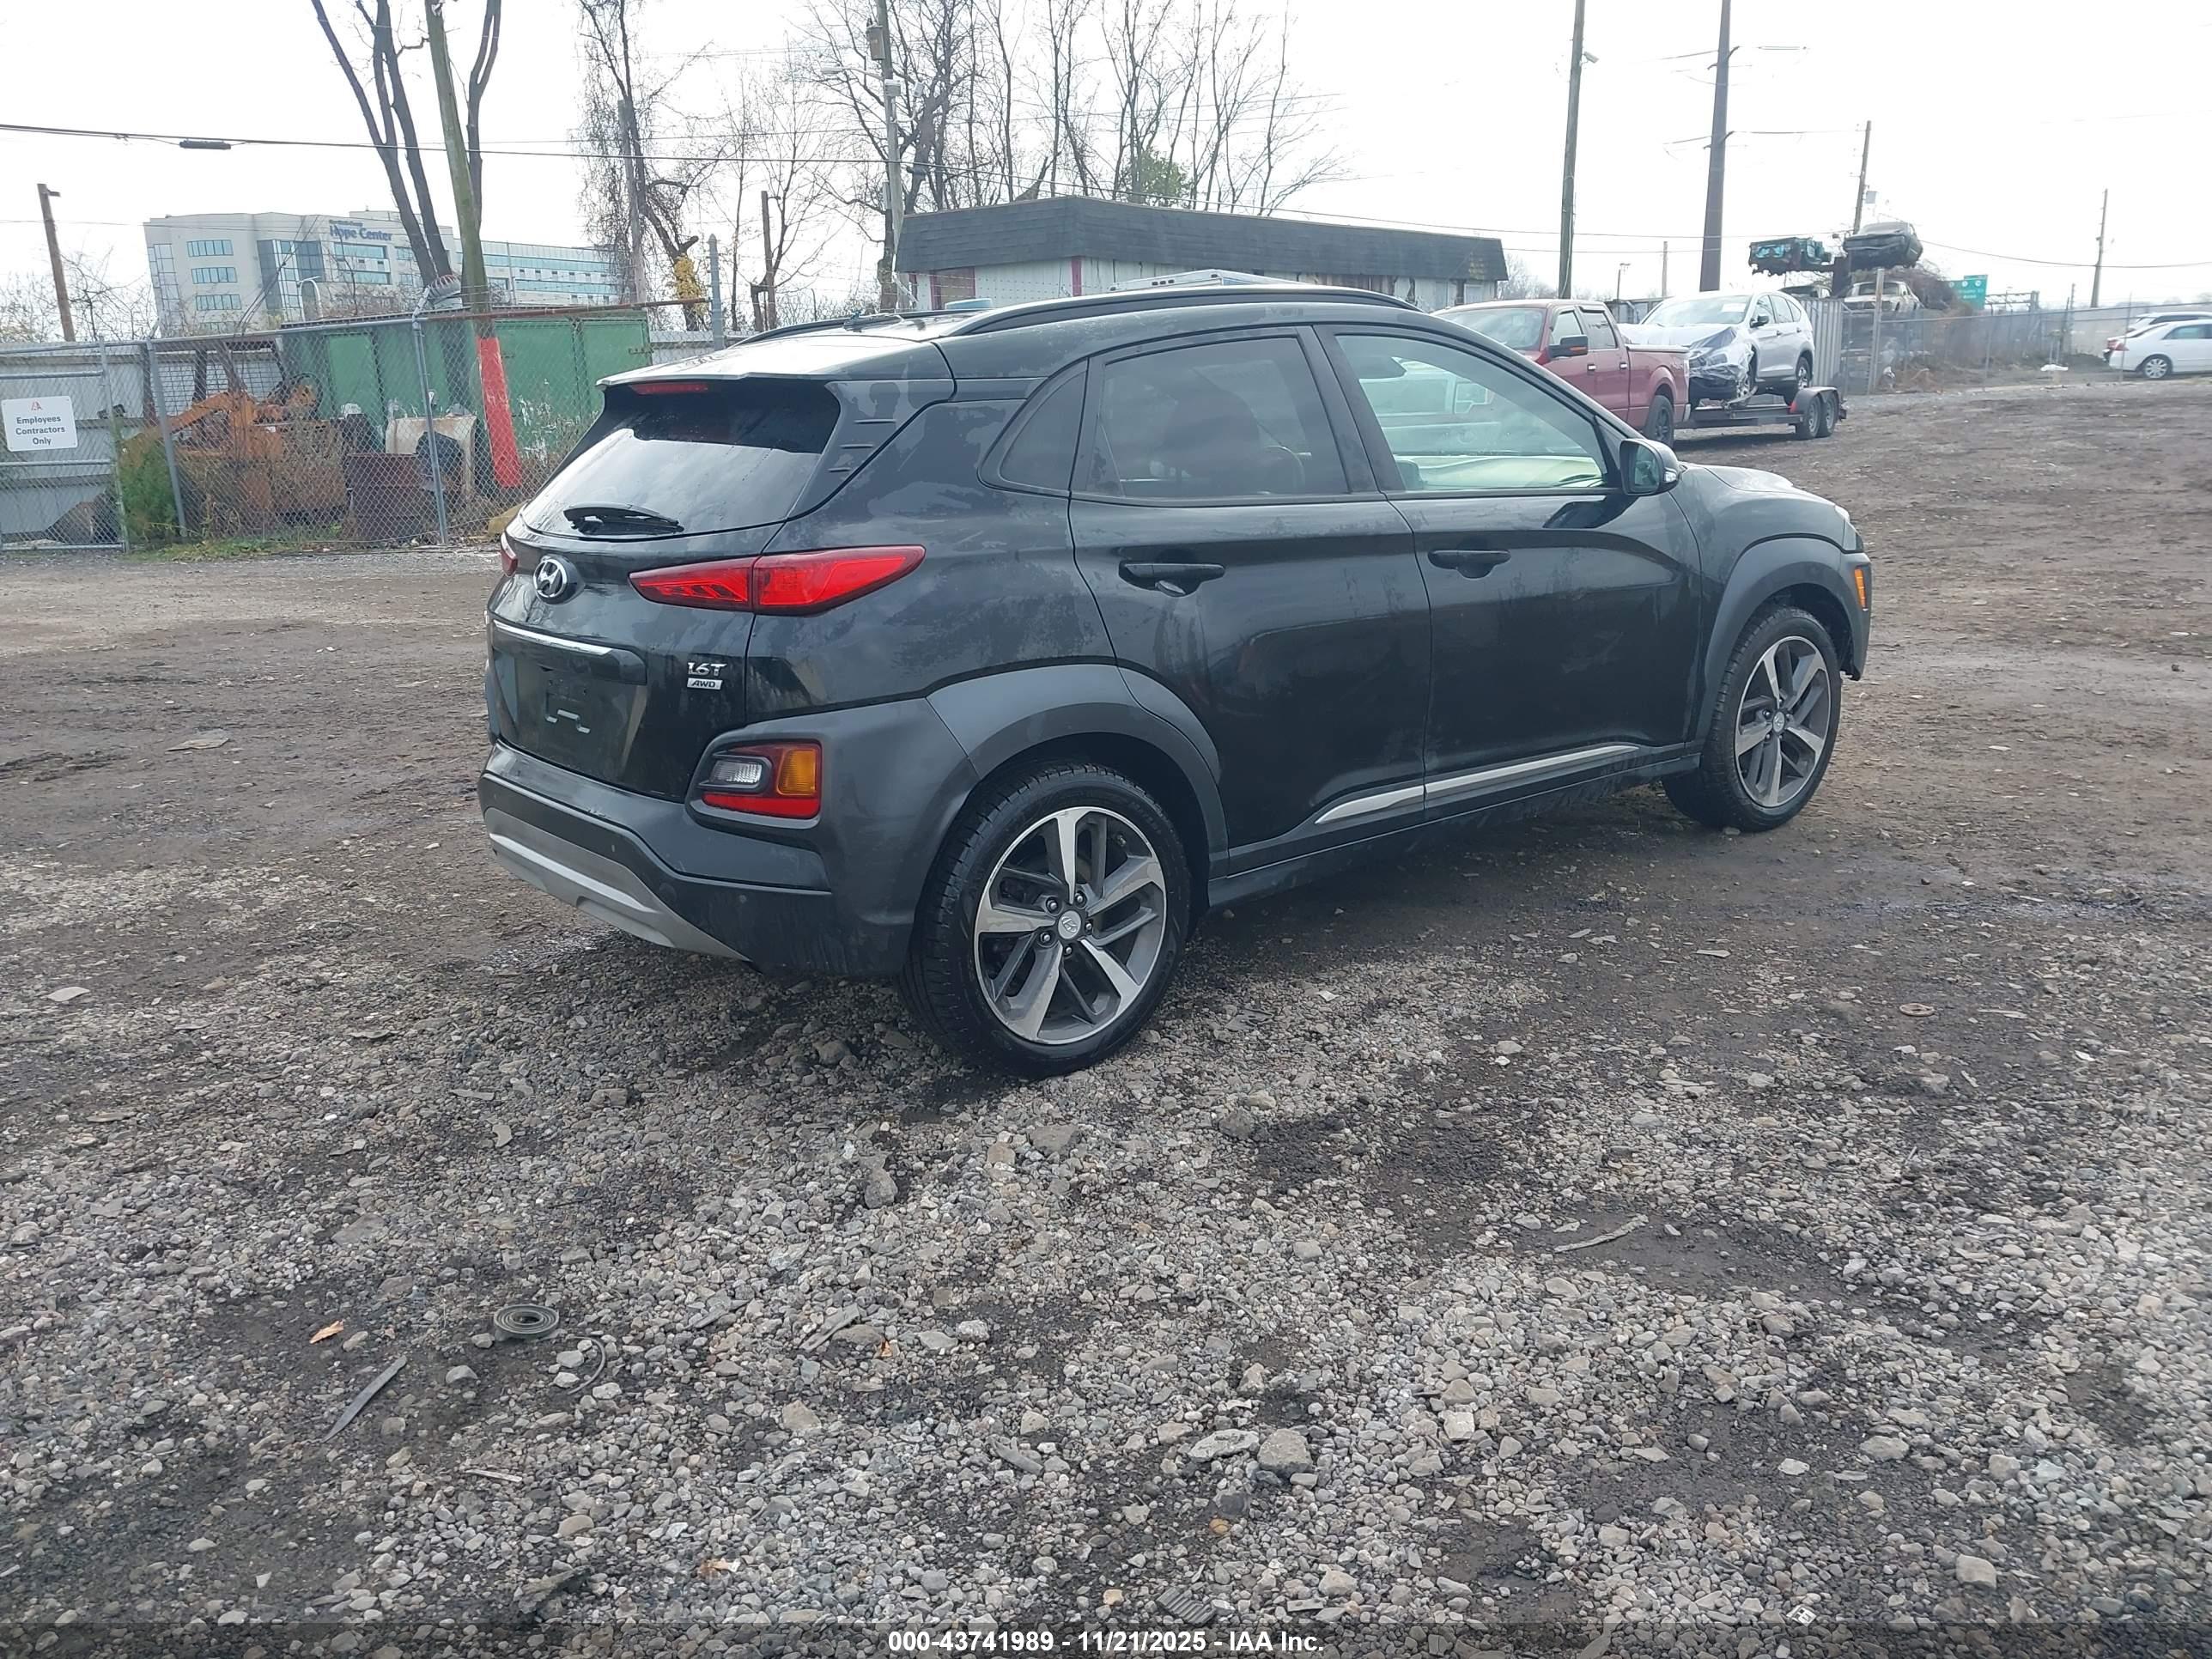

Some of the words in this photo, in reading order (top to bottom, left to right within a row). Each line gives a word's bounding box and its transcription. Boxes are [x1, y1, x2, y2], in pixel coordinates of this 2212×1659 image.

[330, 225, 357, 240] Hope
[360, 227, 392, 240] Center
[16, 416, 61, 425] Employees
[33, 437, 52, 446] Only
